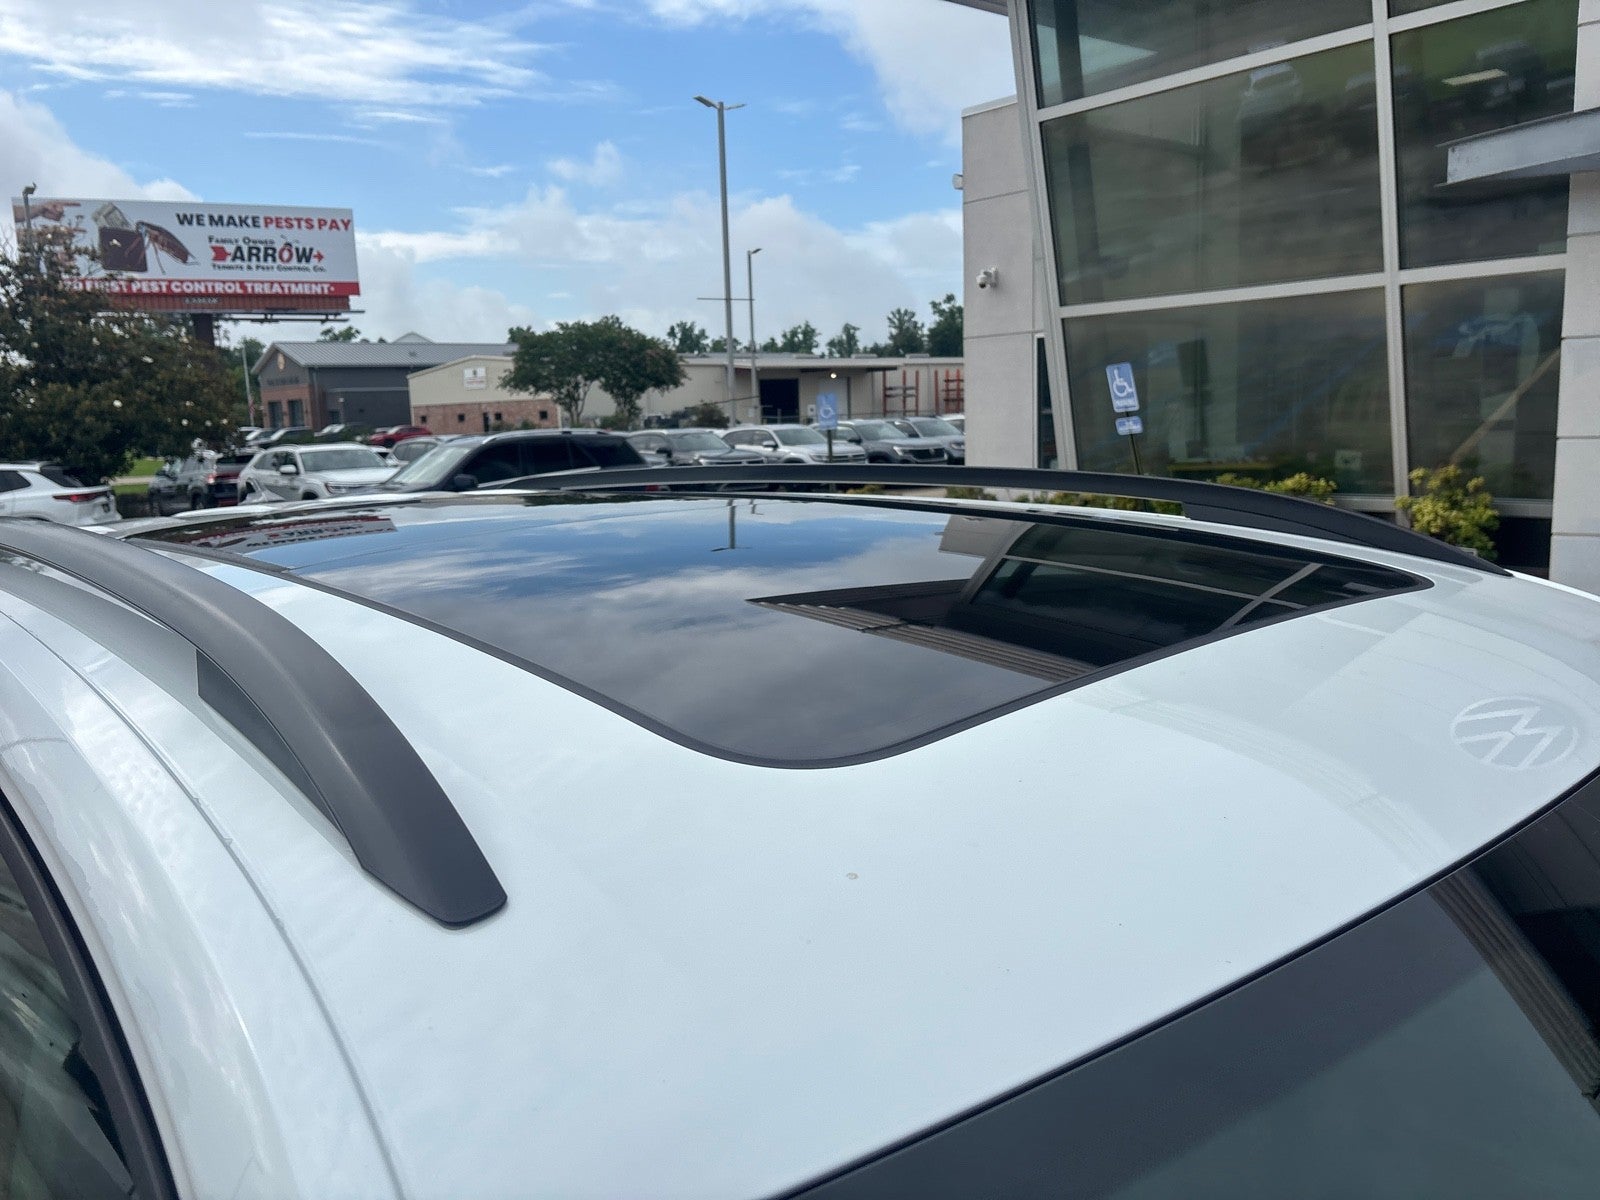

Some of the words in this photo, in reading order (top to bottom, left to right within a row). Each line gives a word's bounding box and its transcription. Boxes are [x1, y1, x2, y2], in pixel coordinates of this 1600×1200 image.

[176, 213, 206, 227] WE
[208, 214, 261, 228] MAKE
[263, 216, 315, 230] PESTS
[317, 218, 353, 231] PAY
[231, 245, 314, 264] ARROW
[131, 280, 169, 294] PEST
[170, 281, 244, 295] CONTROL
